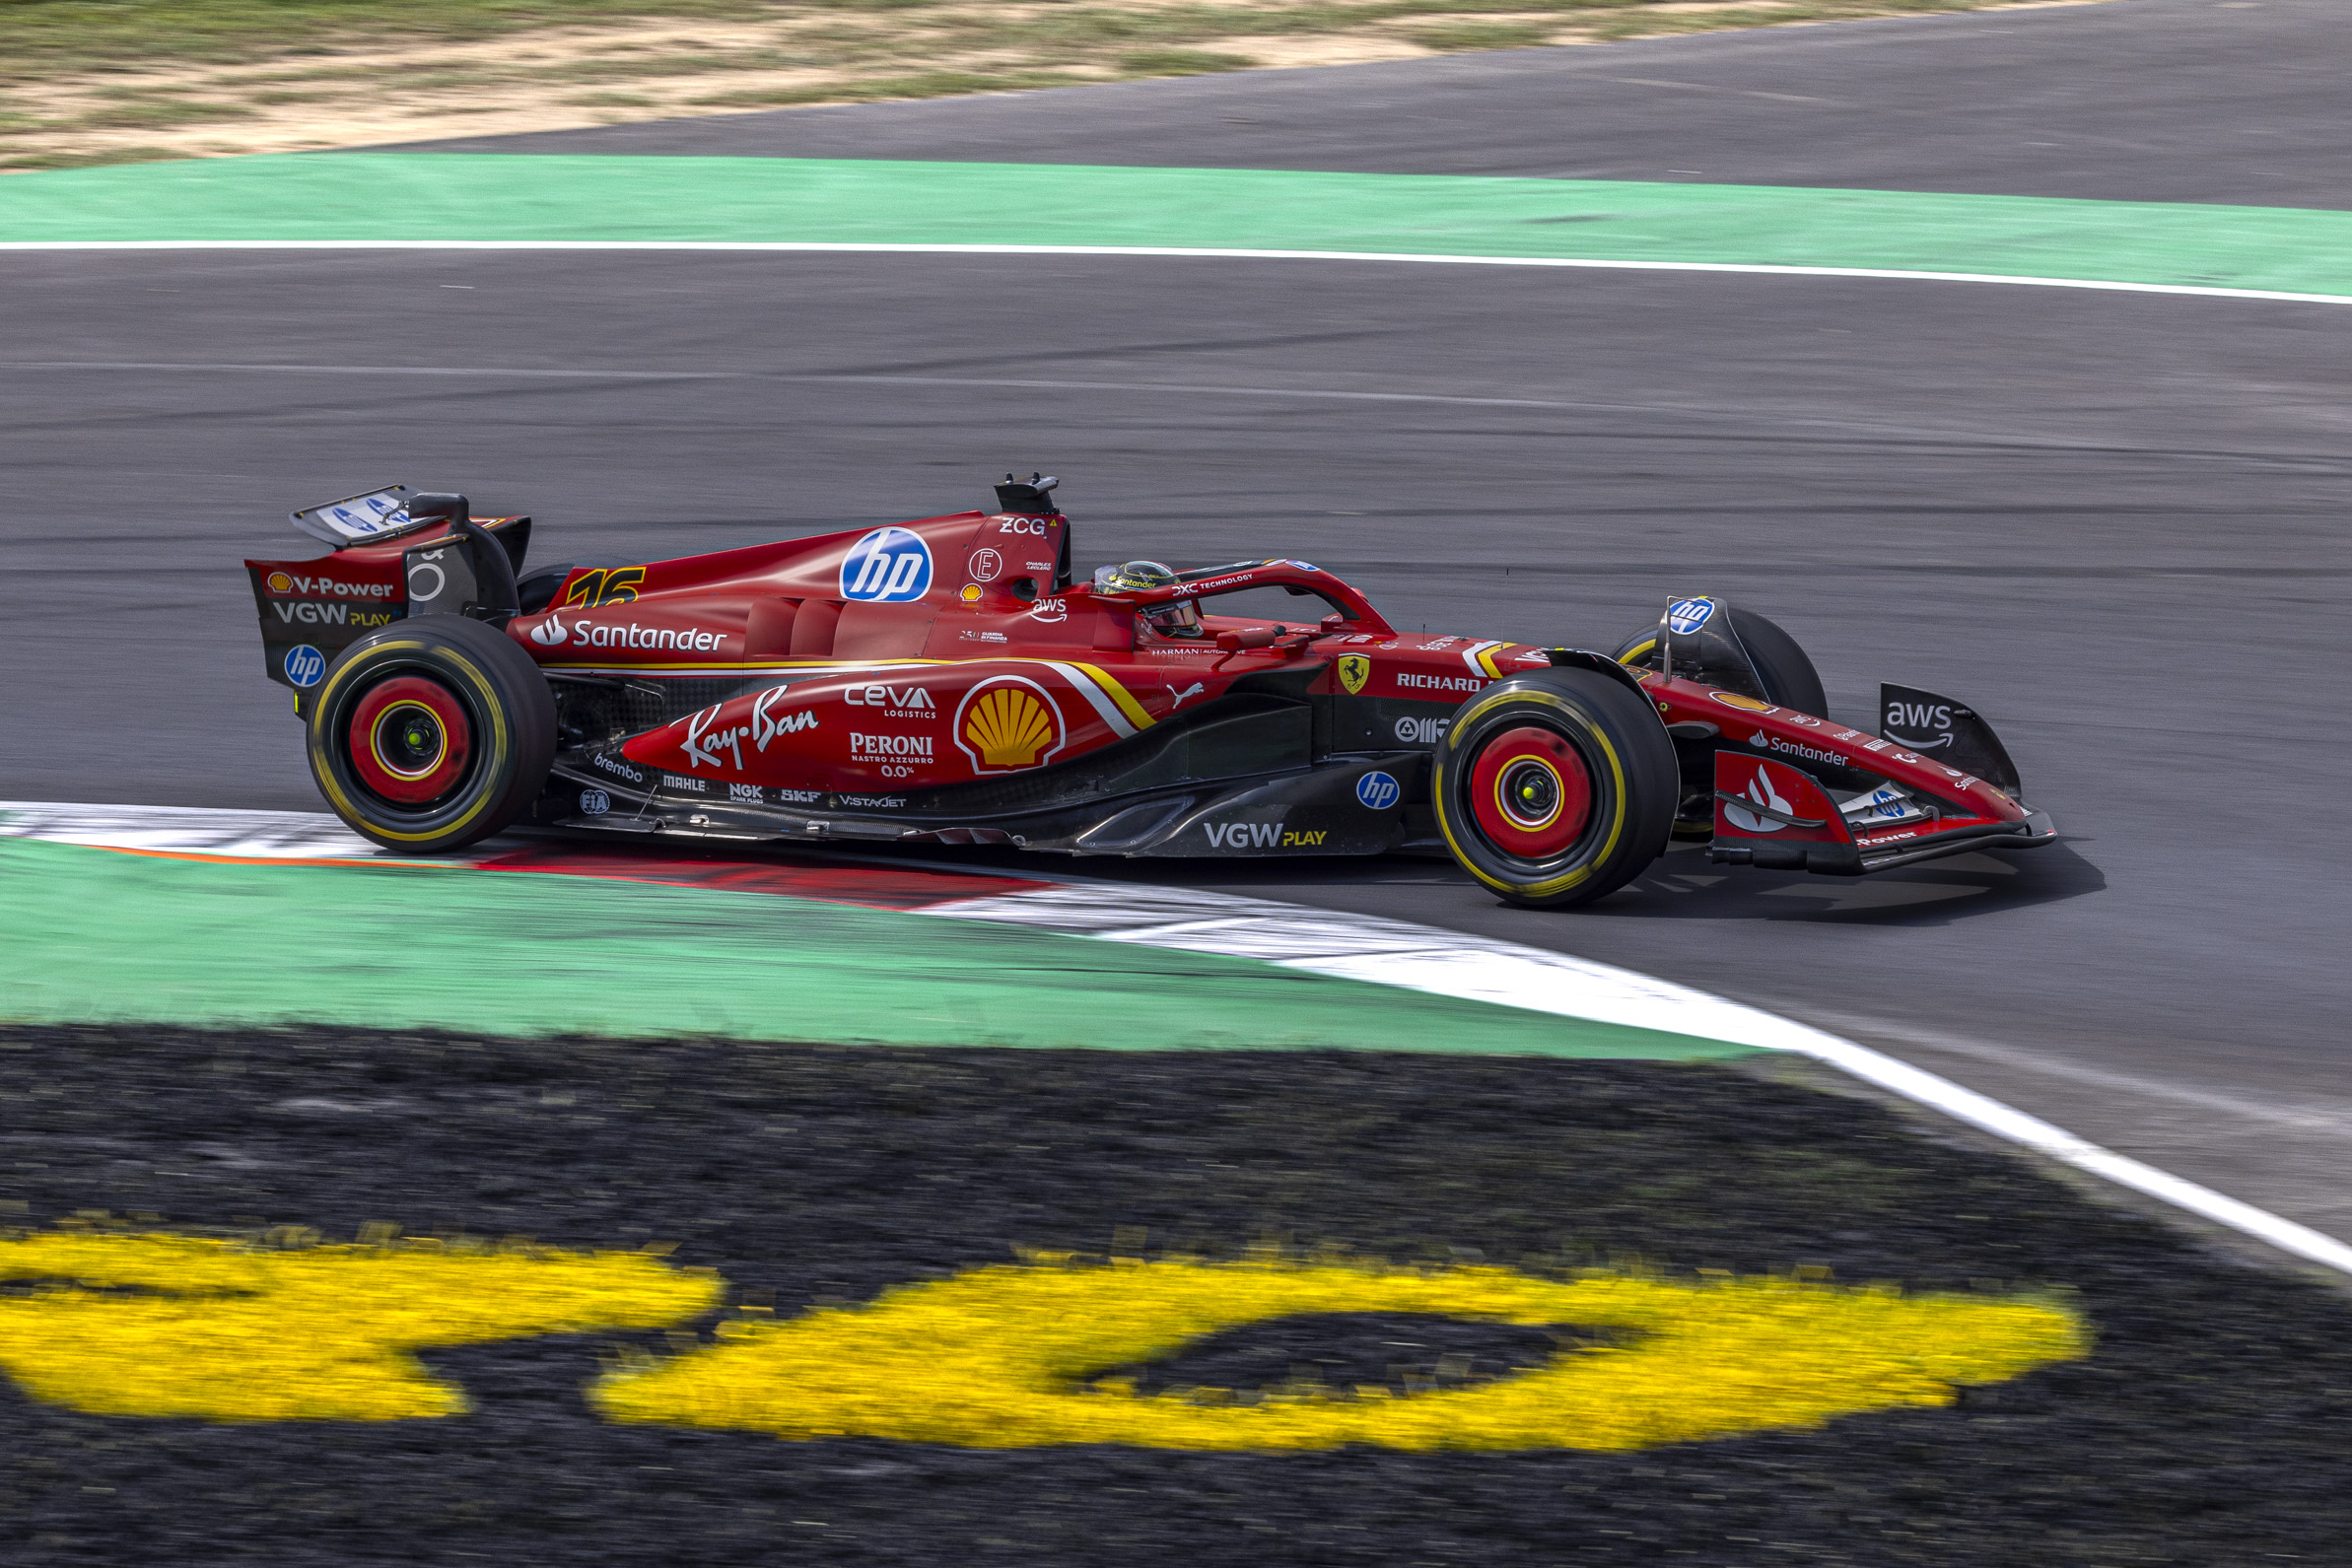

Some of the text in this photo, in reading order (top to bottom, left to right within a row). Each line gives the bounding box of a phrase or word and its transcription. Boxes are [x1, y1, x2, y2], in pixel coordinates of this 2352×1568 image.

[845, 528, 928, 601] hp
[294, 578, 393, 597] V-Power
[1200, 574, 1253, 589] TECHNOLOGY
[273, 601, 390, 627] VGW PLAY
[573, 620, 727, 651] Santander
[289, 646, 321, 686] hp
[1397, 673, 1481, 692] RICHARD
[884, 710, 936, 718] LOGISTICS
[1887, 701, 1952, 730] aws
[849, 732, 934, 755] PERONI
[1770, 737, 1849, 767] Santander
[594, 752, 643, 783] brembo
[880, 765, 915, 778] 0.0%
[663, 775, 706, 792] MAHLE
[728, 784, 763, 798] NGK
[781, 789, 821, 802] SKF
[1360, 772, 1396, 809] hp
[1203, 823, 1328, 848] VGW PLAY
